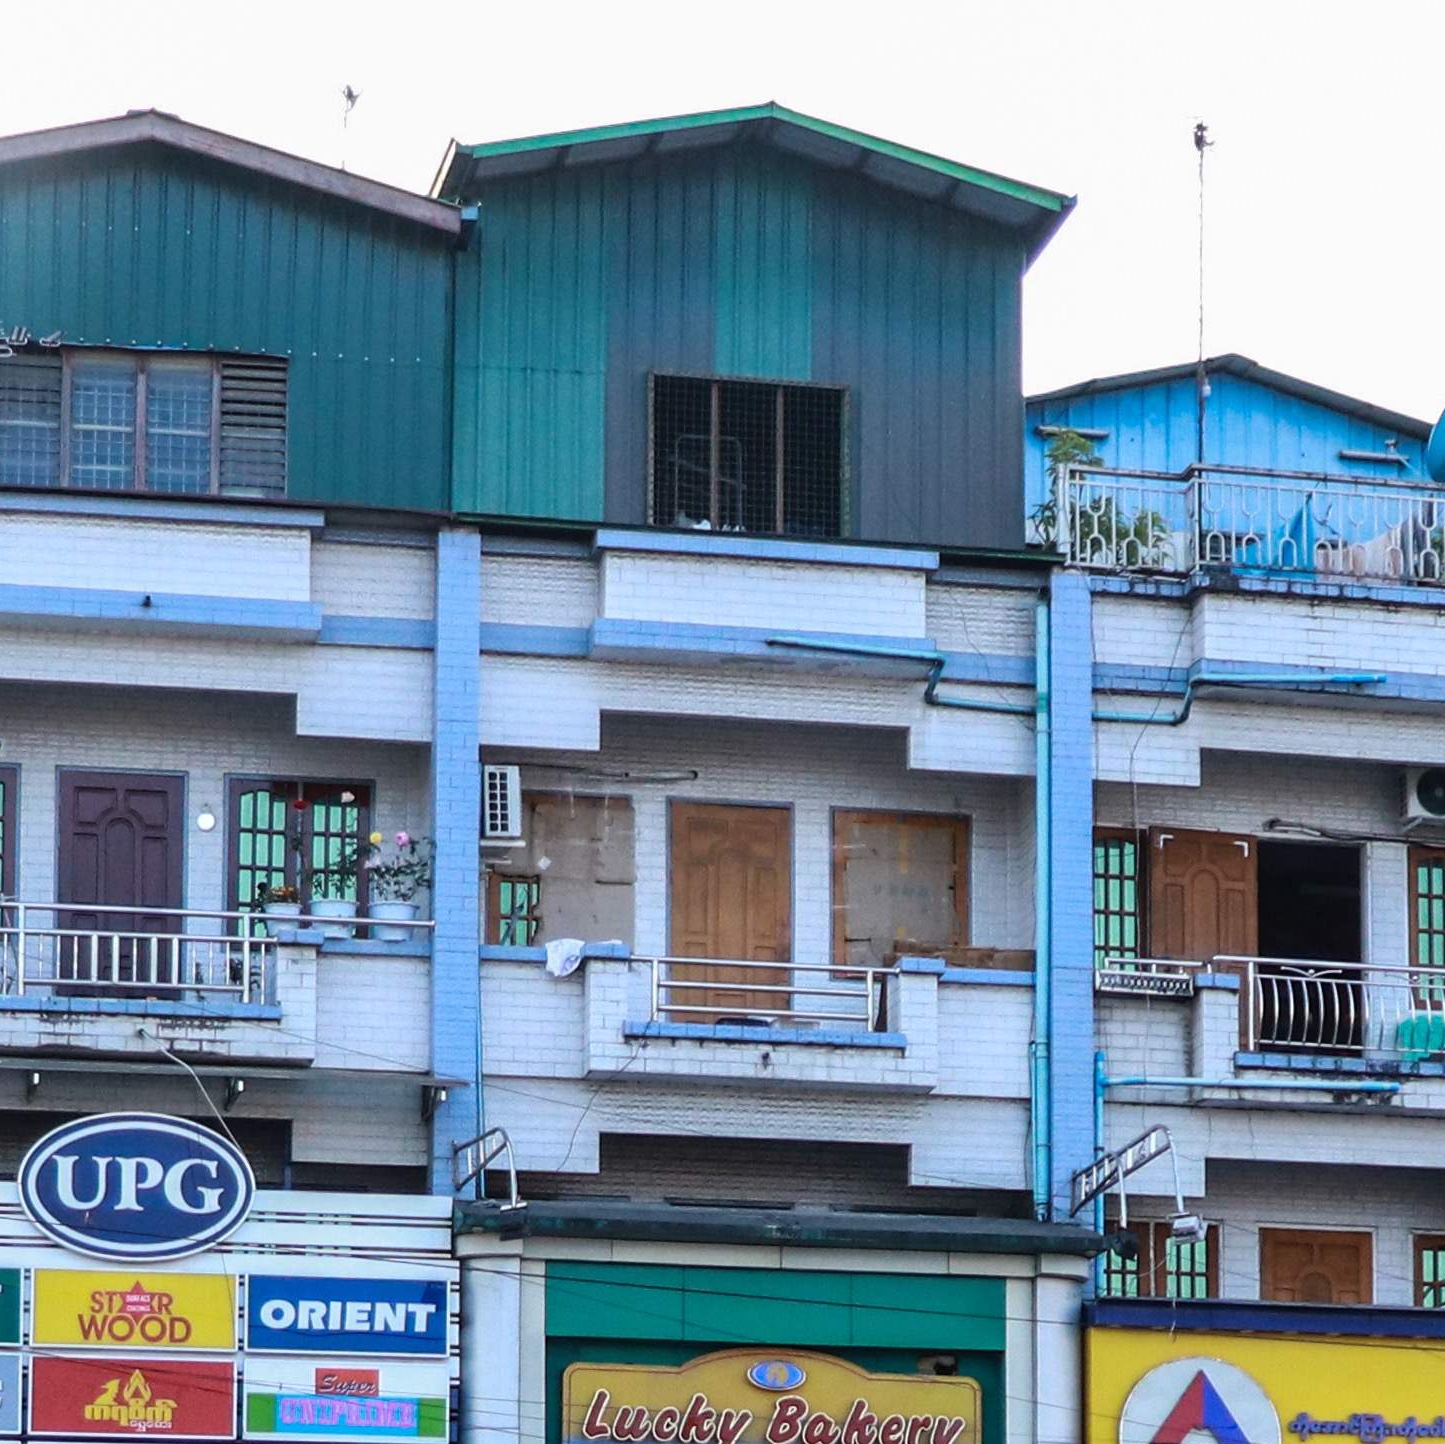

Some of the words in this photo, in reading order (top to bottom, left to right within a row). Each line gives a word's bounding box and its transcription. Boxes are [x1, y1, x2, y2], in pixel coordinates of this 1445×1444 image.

[52, 1155, 224, 1214] UPG
[78, 1314, 192, 1343] WOOD
[260, 1299, 436, 1332] ORIENT
[318, 1374, 378, 1394] Super
[281, 1397, 417, 1428] UNIPRIME
